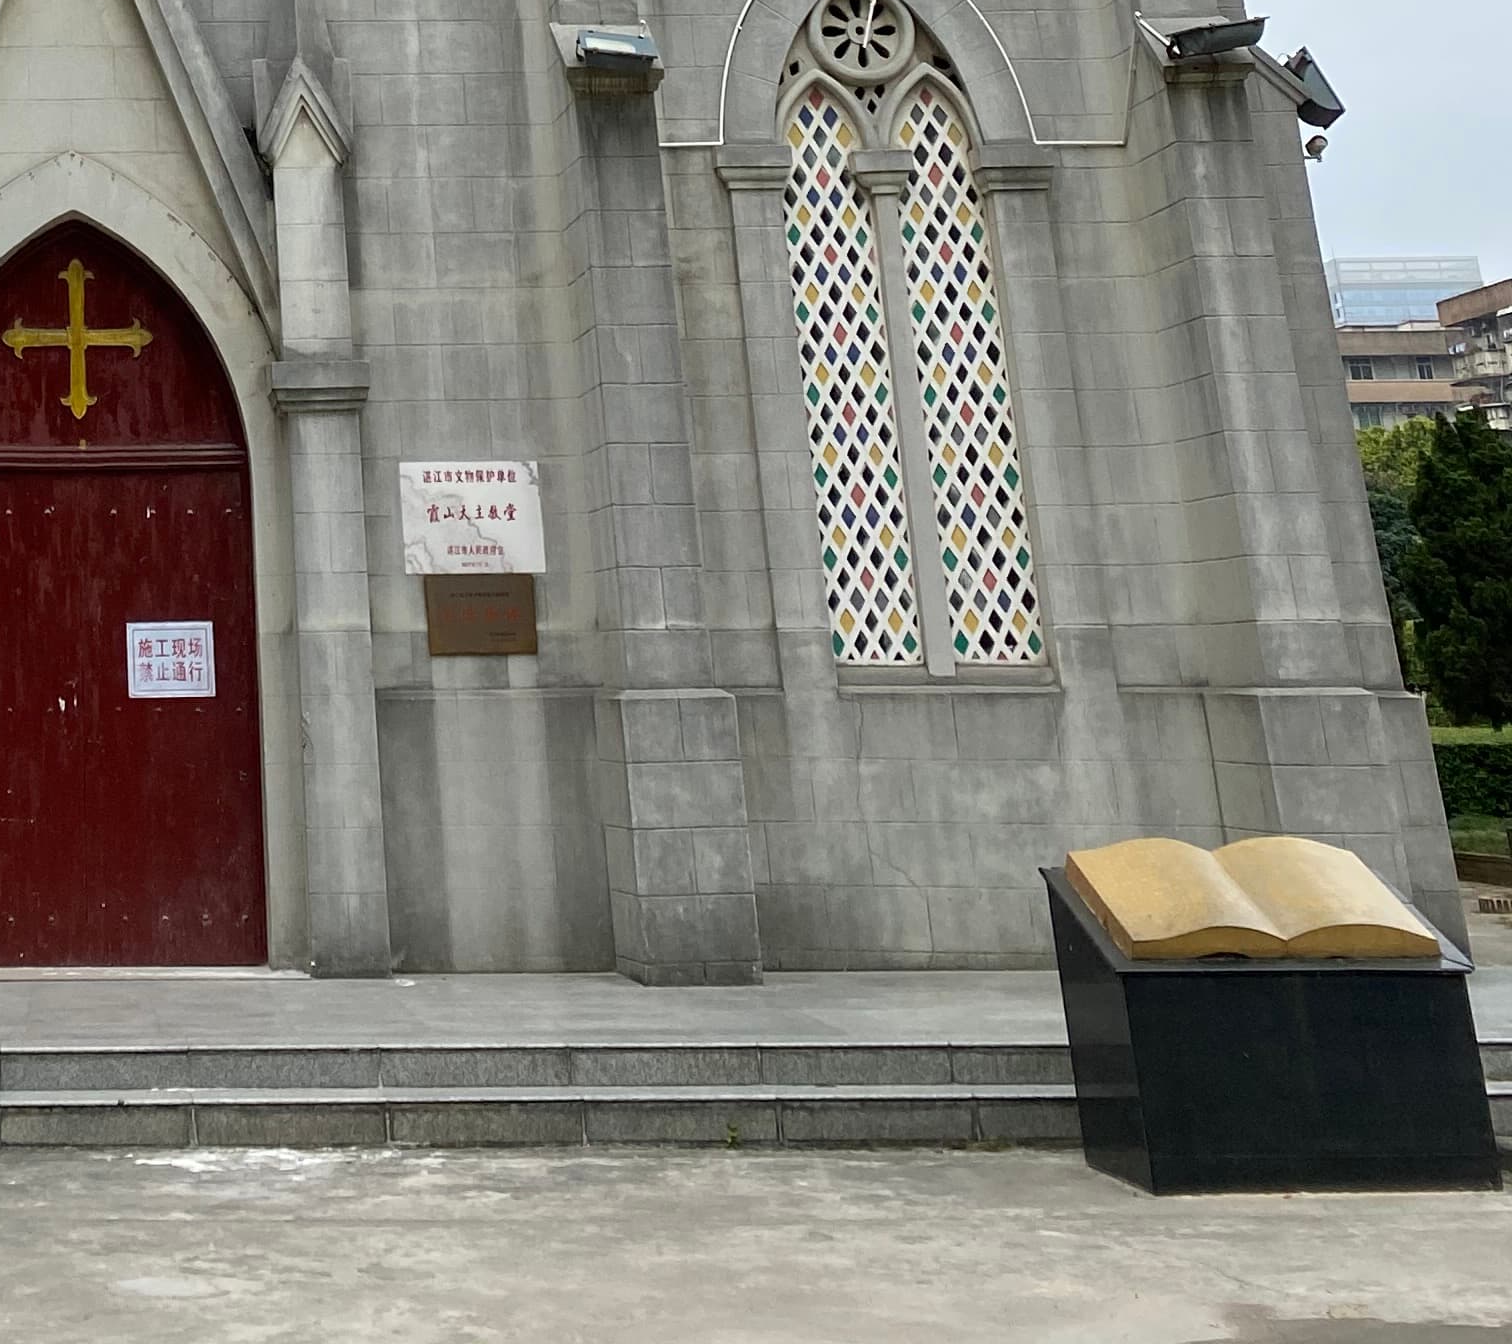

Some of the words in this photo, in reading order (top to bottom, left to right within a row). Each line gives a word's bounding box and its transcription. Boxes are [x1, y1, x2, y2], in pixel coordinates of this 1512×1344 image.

[423, 469, 517, 483] 湛江市文物保护单位
[427, 503, 517, 524] 霞山天主教堂
[138, 637, 203, 658] 施工现场
[138, 661, 203, 683] 禁止通行
